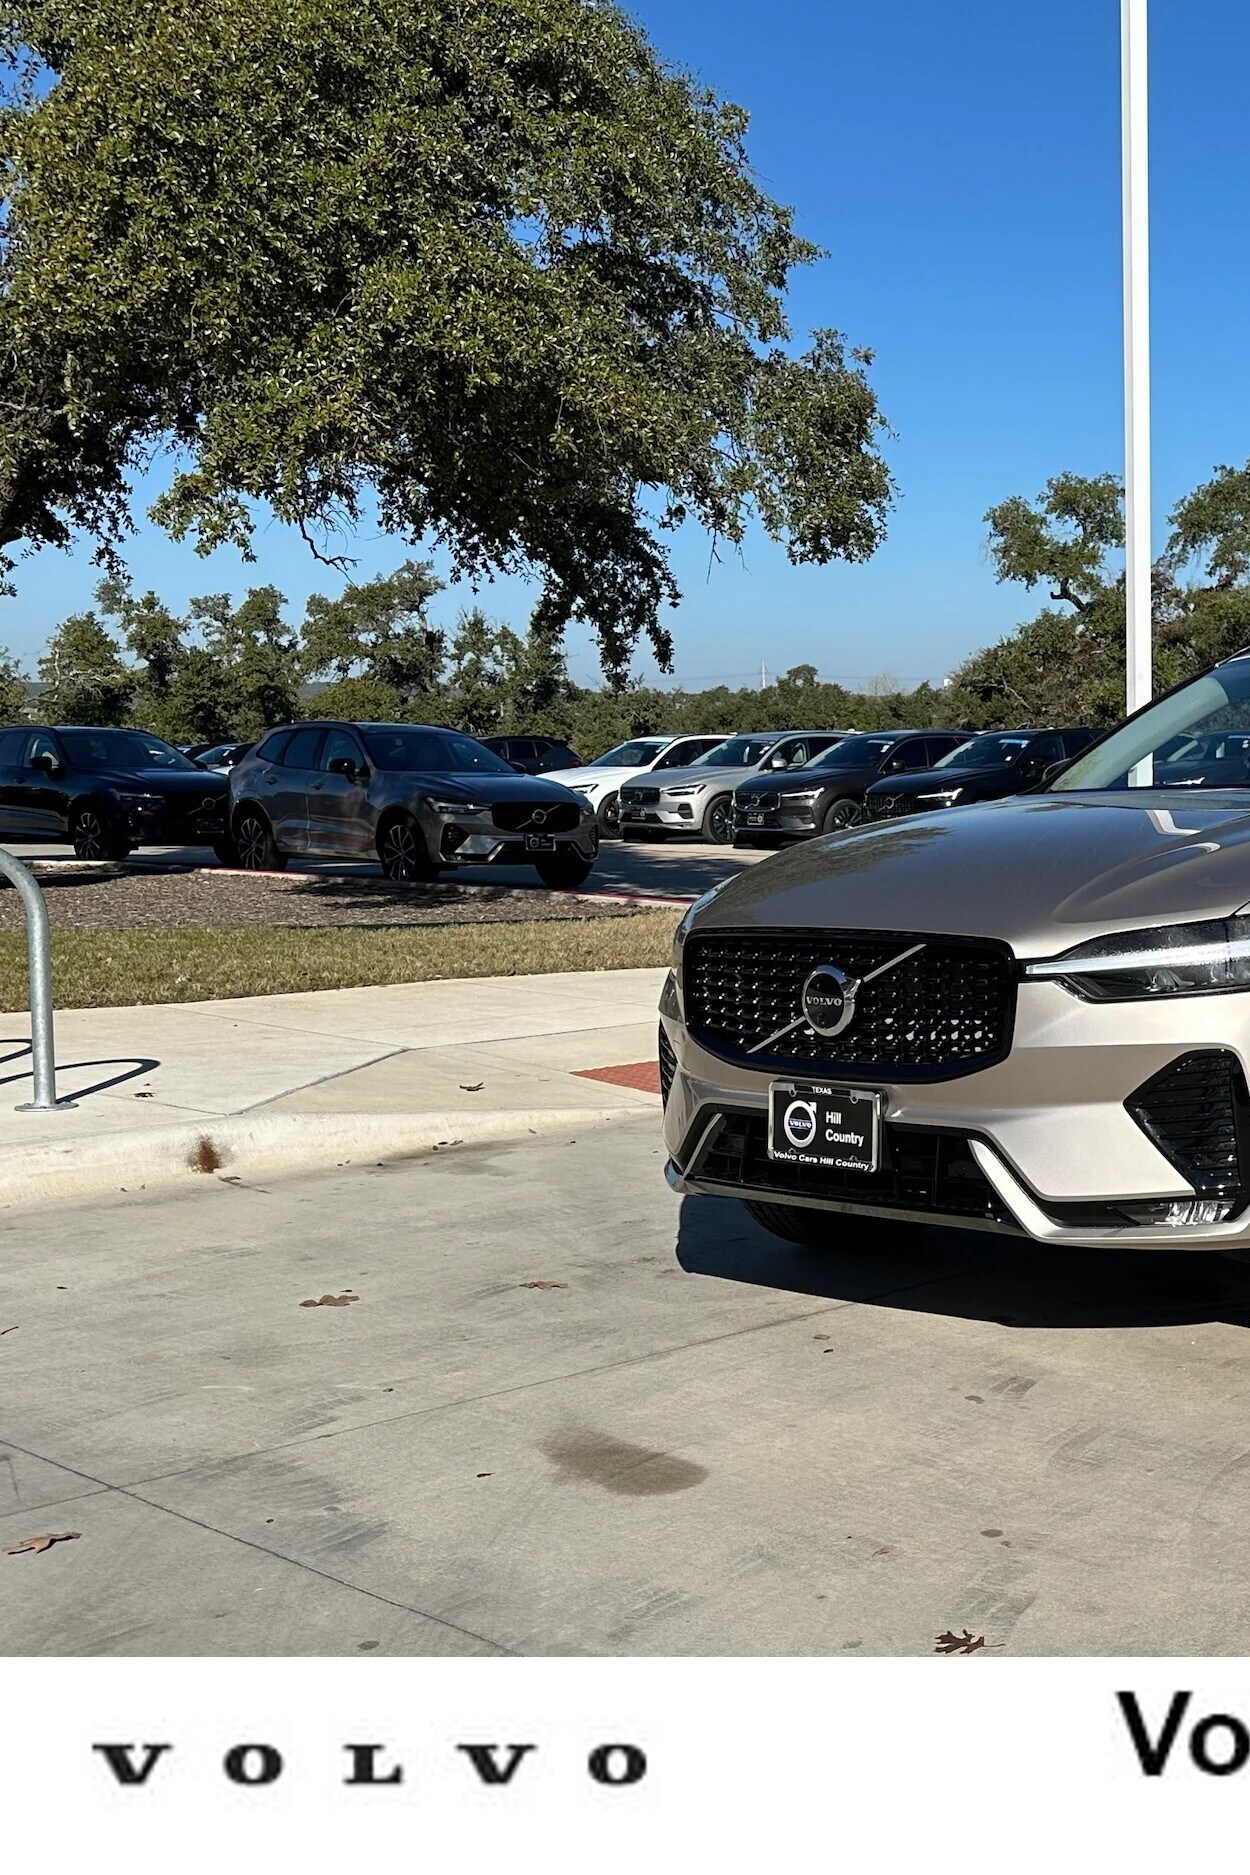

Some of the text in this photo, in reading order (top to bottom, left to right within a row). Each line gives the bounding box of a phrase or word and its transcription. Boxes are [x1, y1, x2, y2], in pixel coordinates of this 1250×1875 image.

[806, 996, 842, 1006] VOLVO
[811, 1086, 832, 1095] TEXAS
[825, 1111, 842, 1125] Hill
[789, 1120, 812, 1129] VOLVO
[825, 1129, 864, 1147] Country
[774, 1151, 870, 1171] Volvo Cars Hill Country
